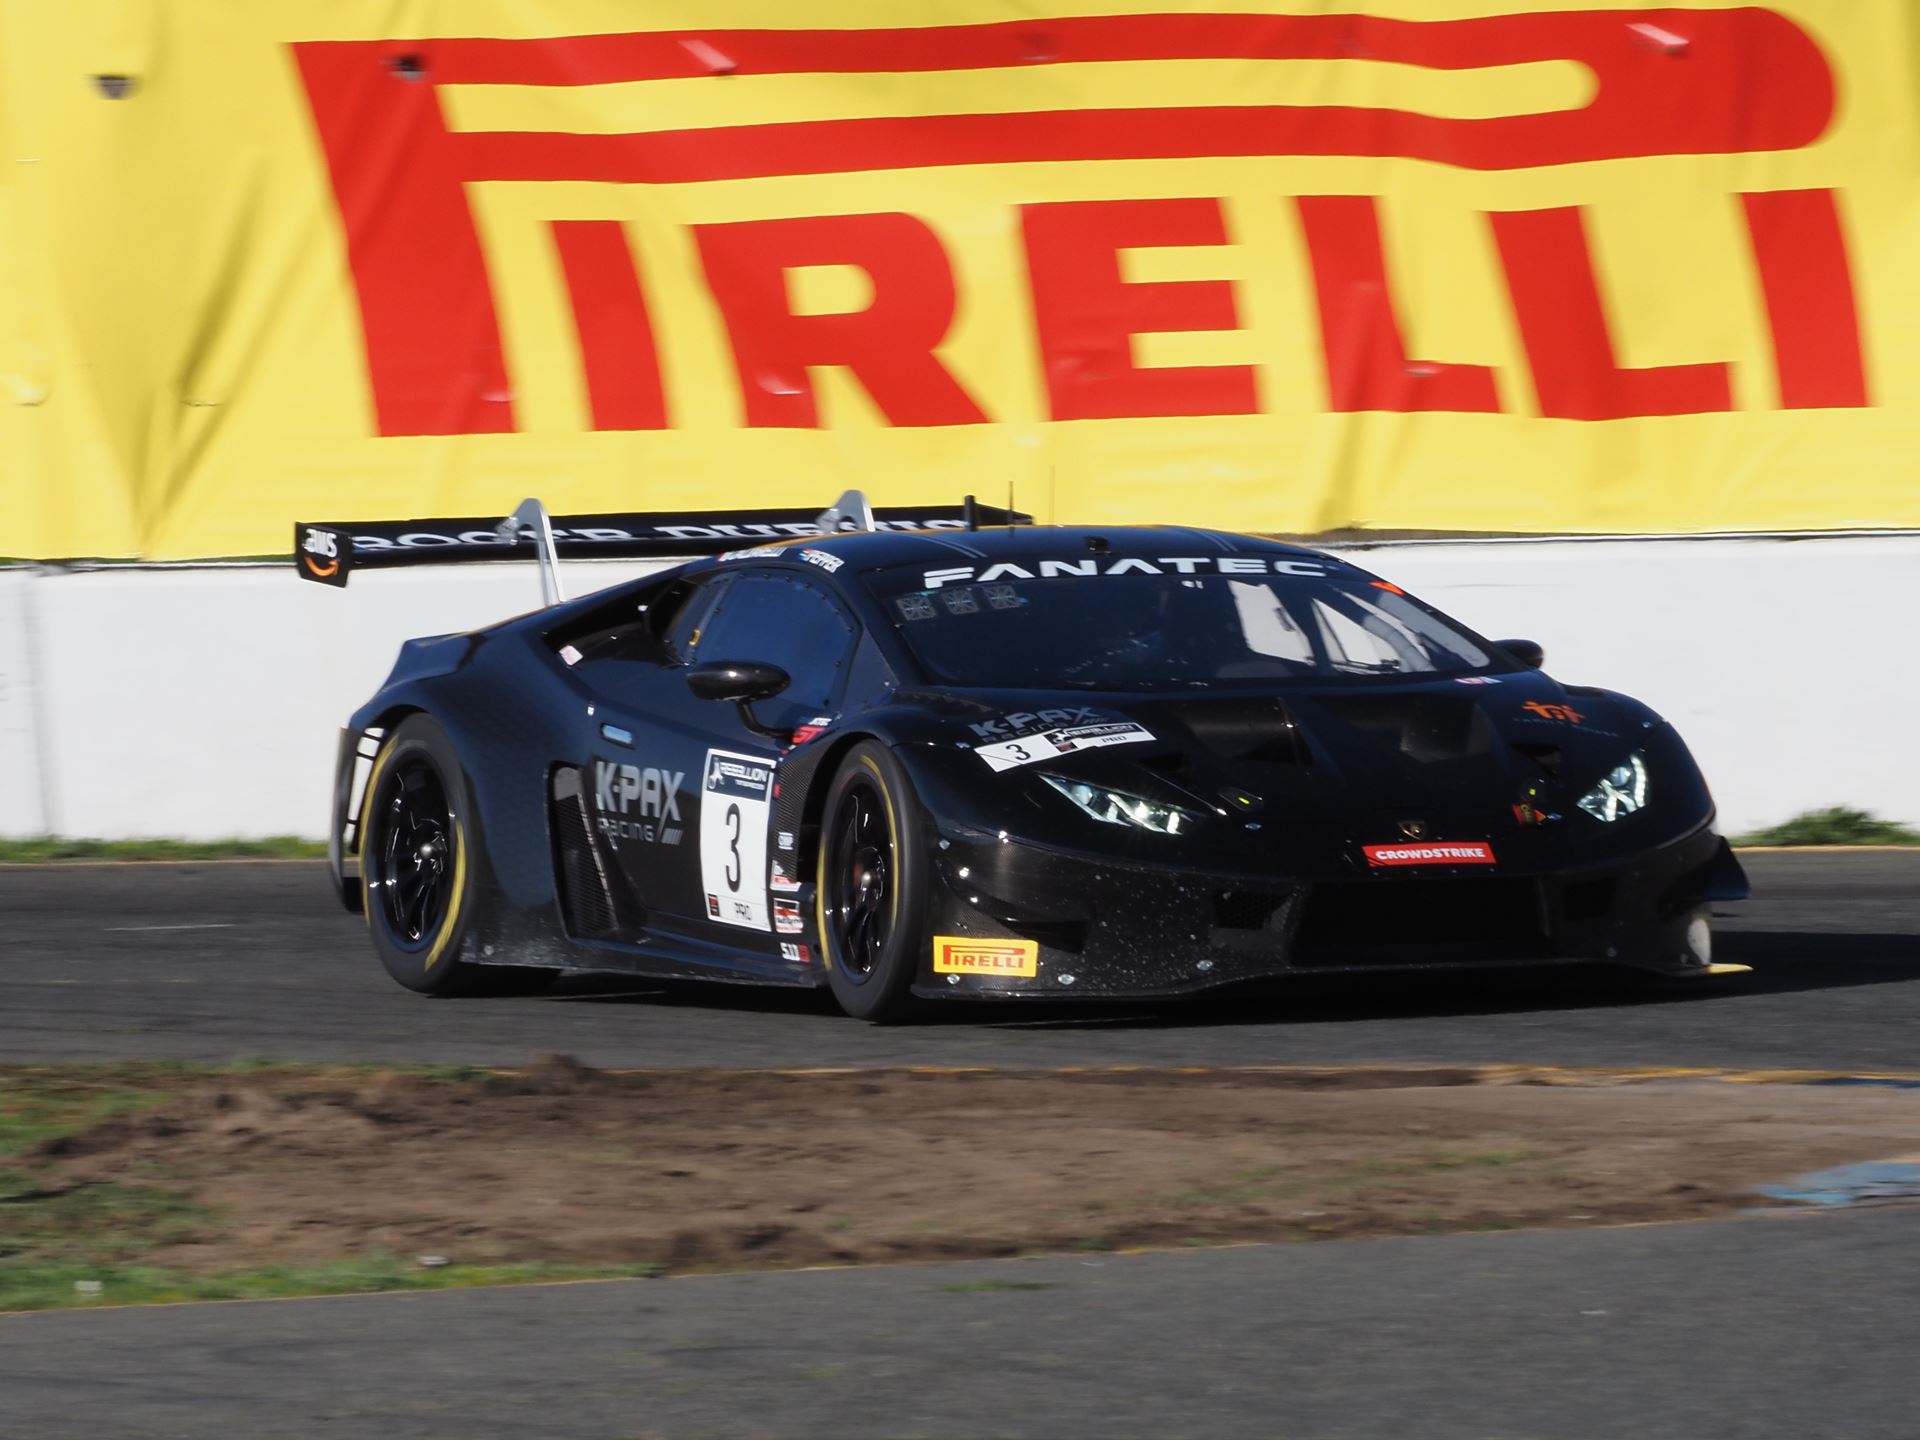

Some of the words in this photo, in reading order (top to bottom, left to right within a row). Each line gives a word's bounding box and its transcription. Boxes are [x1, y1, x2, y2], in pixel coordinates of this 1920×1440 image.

[284, 6, 1874, 437] PIRELLI
[302, 528, 338, 558] aws
[923, 557, 1328, 590] FANATEC
[968, 706, 1102, 738] K-PAX
[1005, 743, 1032, 762] 3
[1101, 735, 1128, 743] PRO
[596, 760, 685, 826] K-PAX
[725, 802, 742, 893] 3
[1375, 847, 1486, 860] CROWDSTRIKE
[942, 944, 1026, 969] PIRELLI
